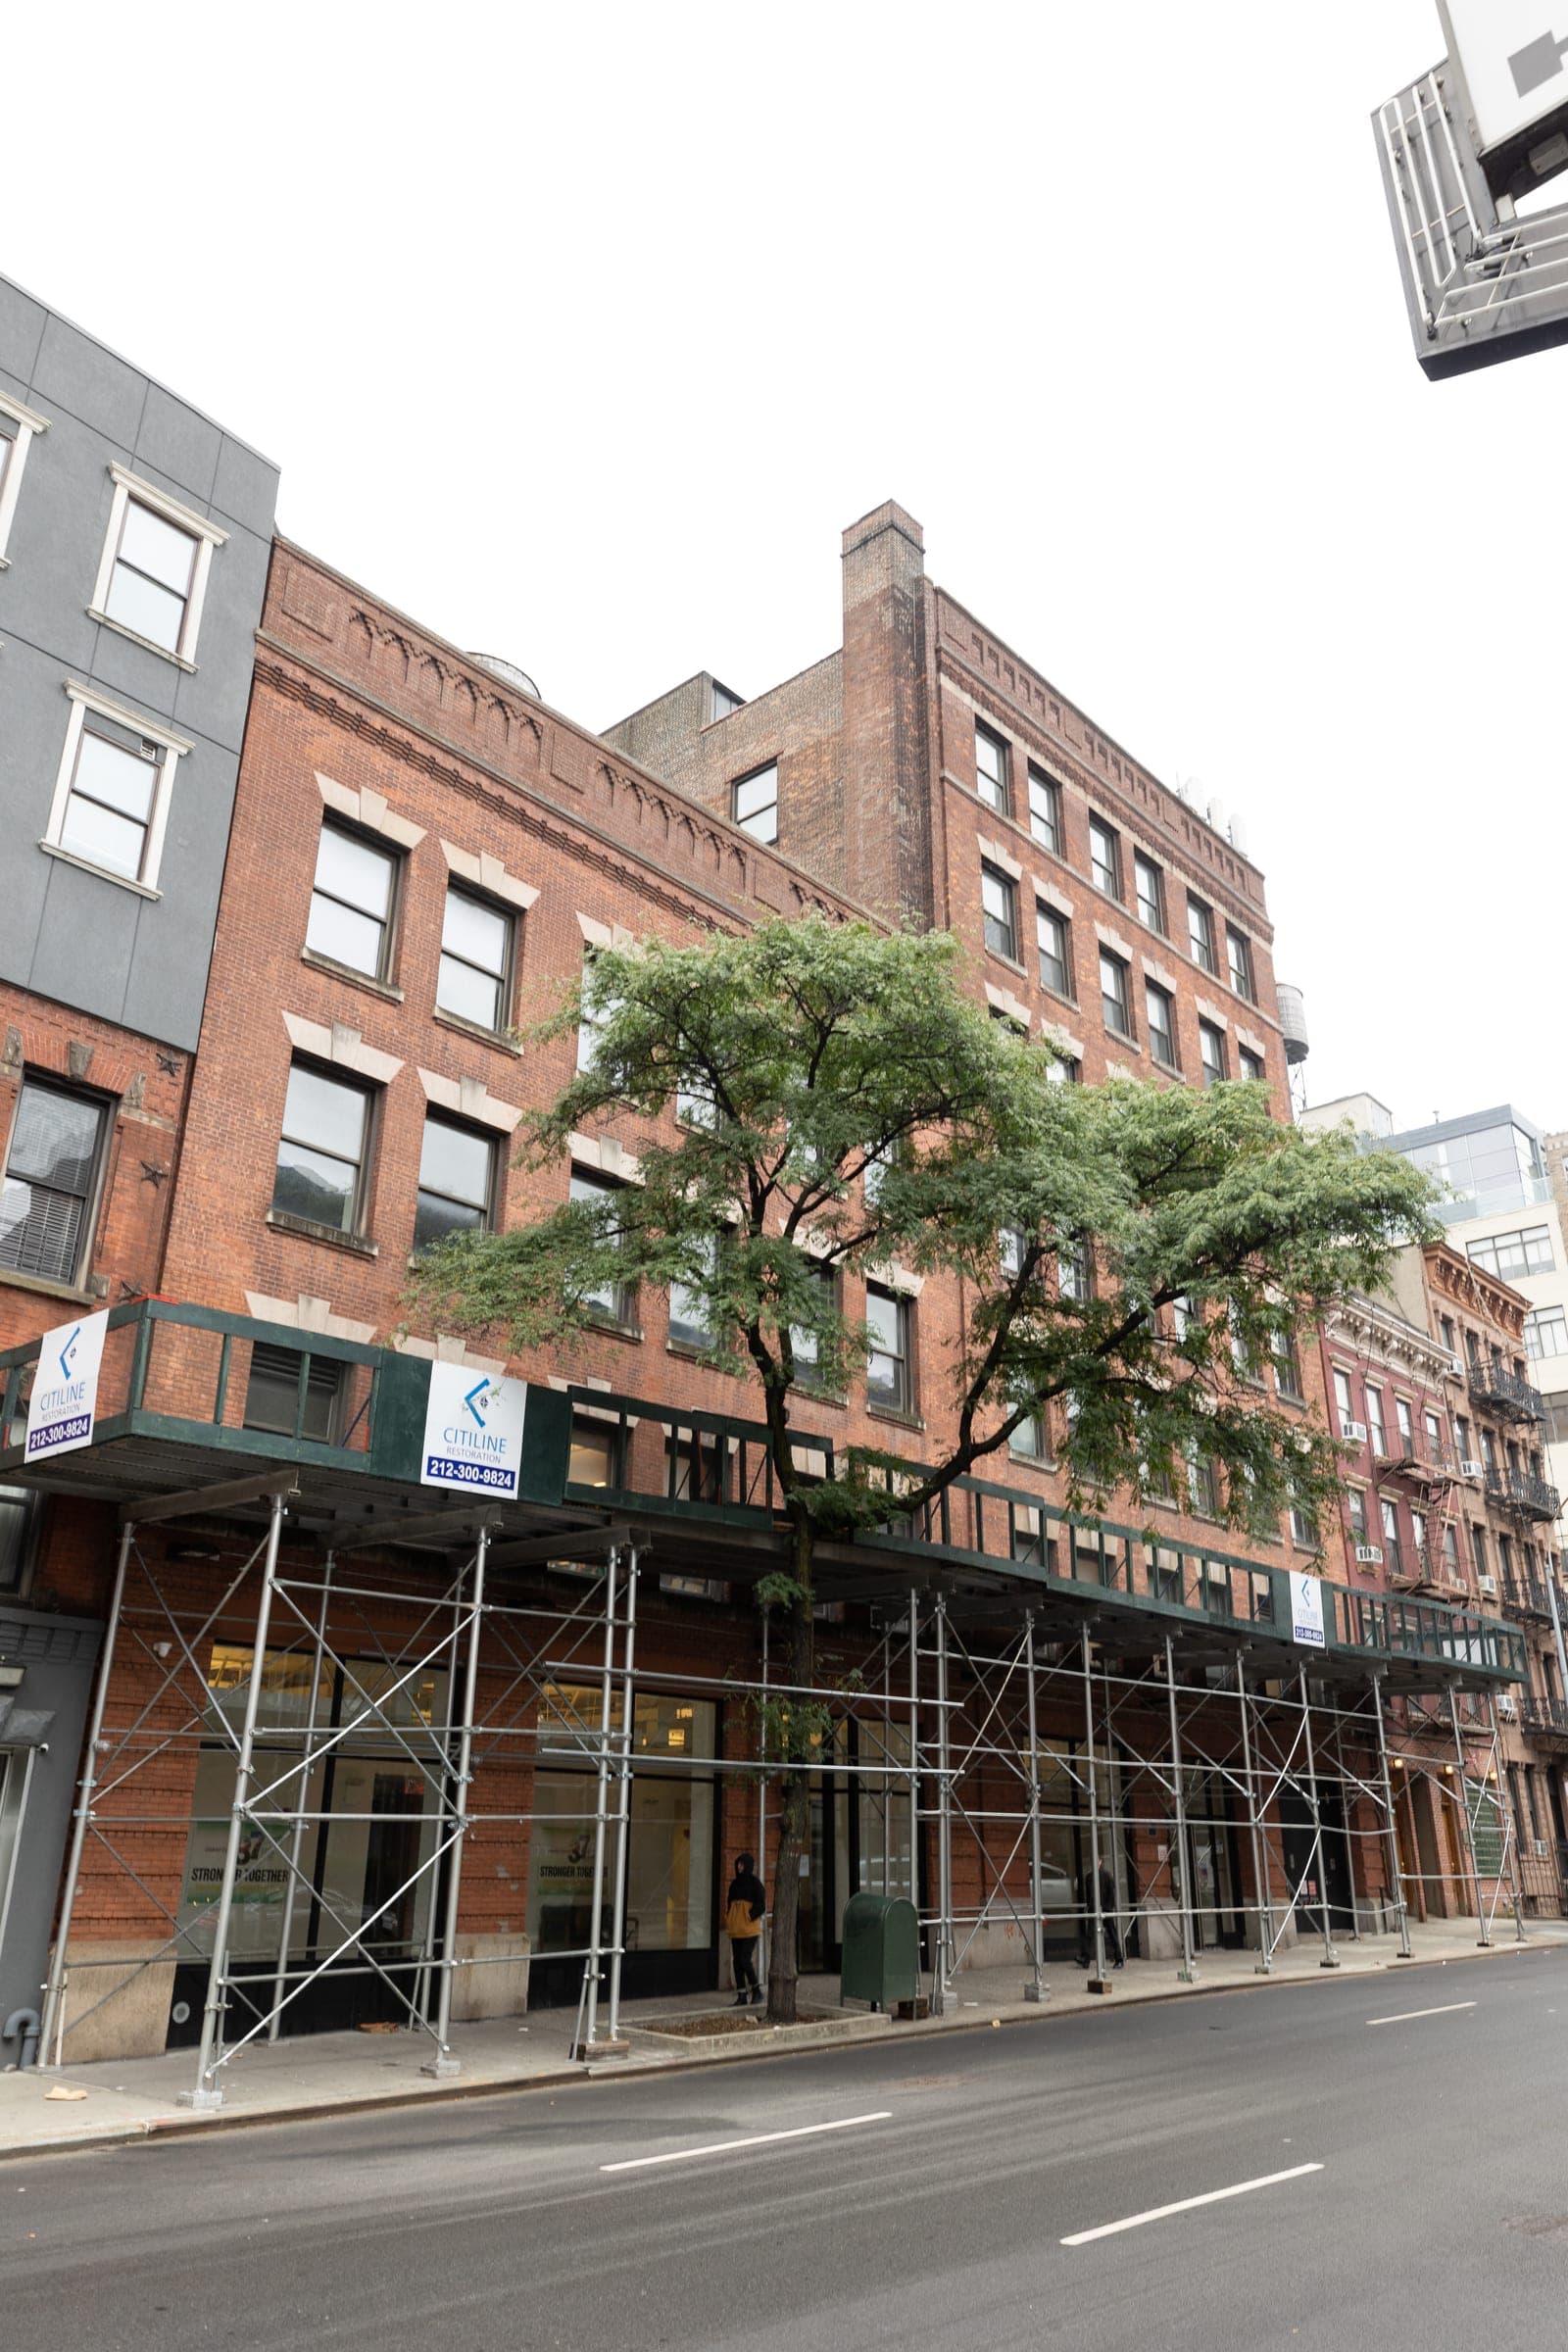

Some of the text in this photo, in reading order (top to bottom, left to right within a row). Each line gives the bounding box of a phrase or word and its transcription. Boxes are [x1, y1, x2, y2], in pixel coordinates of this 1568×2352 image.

[40, 1382, 86, 1411] CITILINE
[42, 1402, 80, 1422] RESTORATION
[30, 1417, 89, 1449] 212-300-9824
[443, 1427, 507, 1454] CITILINE
[447, 1445, 501, 1464] RESTORATION
[430, 1459, 512, 1487] 212-300-9824
[191, 1867, 242, 1882] STRONR
[540, 1865, 609, 1879] STRONGER TOGER
